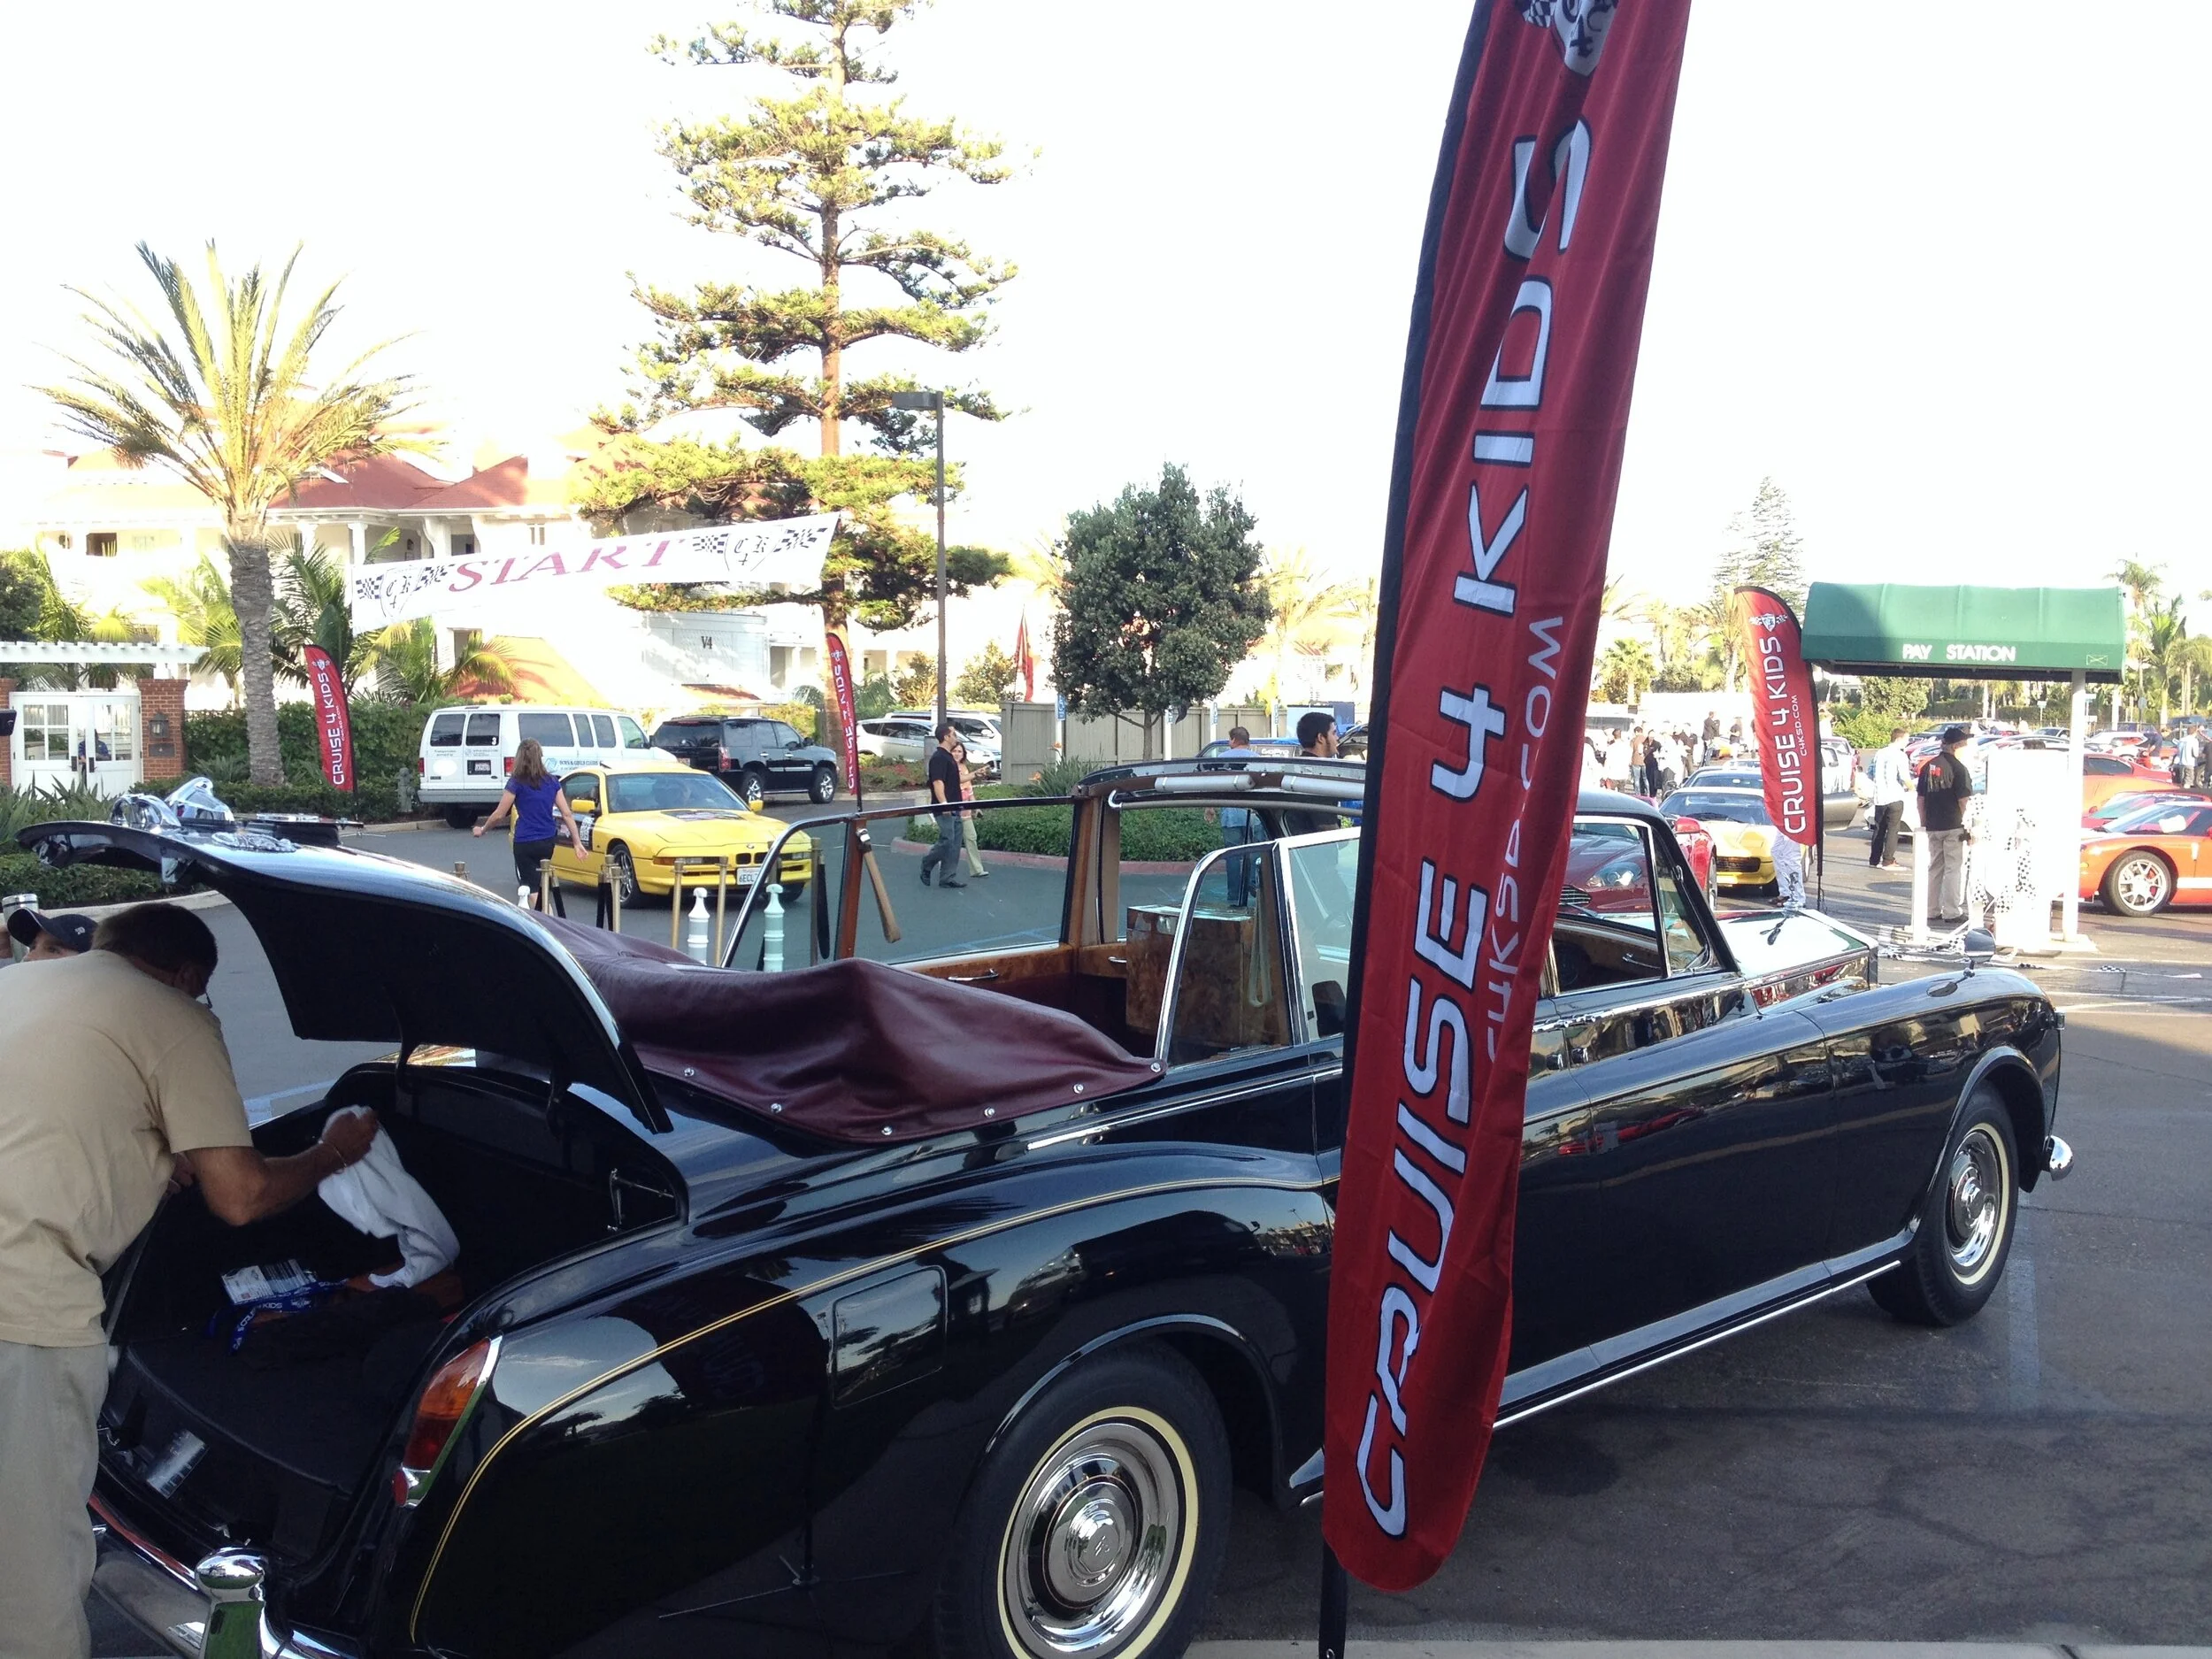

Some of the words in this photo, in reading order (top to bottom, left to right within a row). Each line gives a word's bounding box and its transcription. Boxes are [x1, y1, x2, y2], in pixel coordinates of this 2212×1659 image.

[1454, 117, 1591, 614] KIDS
[448, 539, 686, 593] START
[701, 636, 713, 649] V4
[1759, 635, 1787, 702] KIDS
[1902, 644, 1932, 660] PAY
[1946, 644, 2016, 662] STATION
[318, 672, 335, 709] KIDS
[326, 711, 337, 725] 4
[1771, 707, 1788, 726] 4
[491, 737, 497, 746] 3
[1430, 683, 1505, 798] 4
[1792, 695, 1808, 757] C4KSD.COM
[327, 727, 345, 785] CRUISE
[1775, 733, 1807, 833] CRUISE
[1356, 858, 1490, 1541] CRUISE
